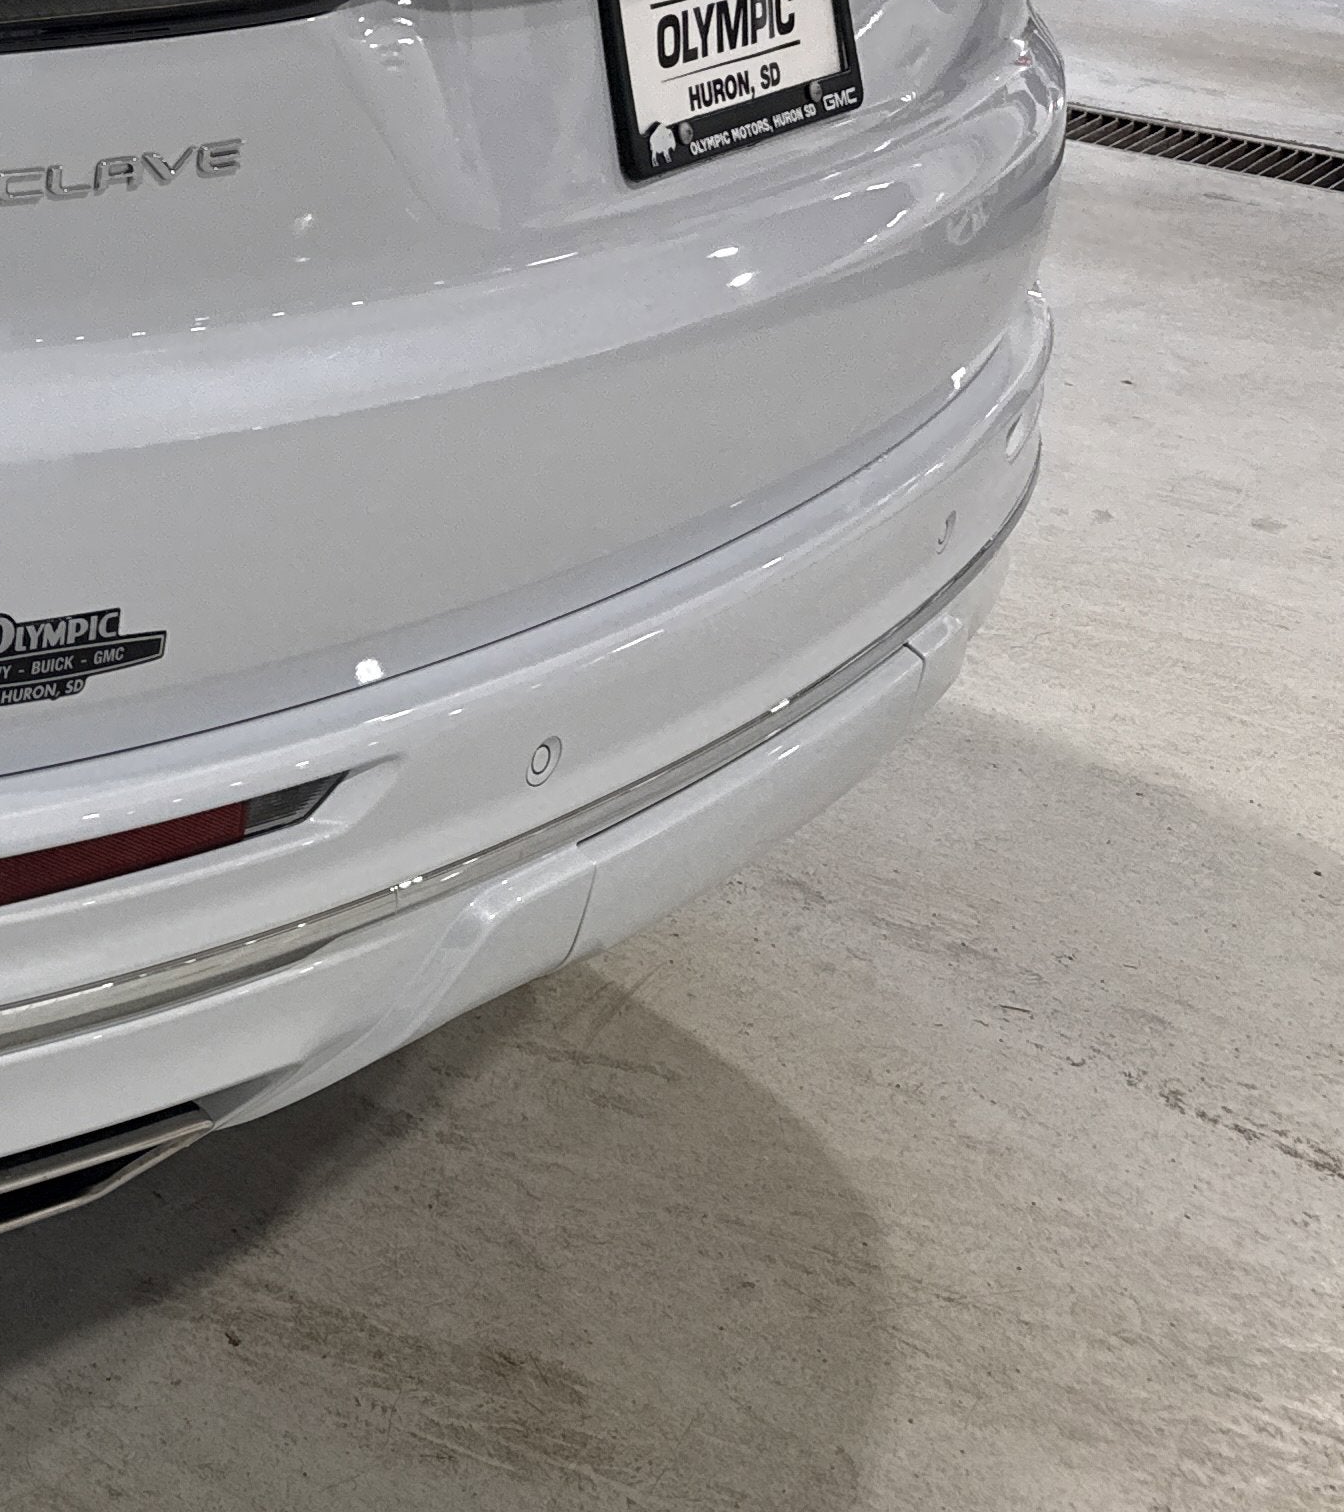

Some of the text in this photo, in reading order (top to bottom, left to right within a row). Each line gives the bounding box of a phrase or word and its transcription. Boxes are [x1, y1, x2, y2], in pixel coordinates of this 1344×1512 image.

[688, 62, 780, 111] HURON, SD
[822, 87, 858, 111] GMC
[689, 103, 817, 156] OLYMPIC MOTORS, HURON SD
[31, 656, 74, 675] BUICK
[94, 646, 125, 665] GMC
[1, 678, 84, 705] HURON, SD
